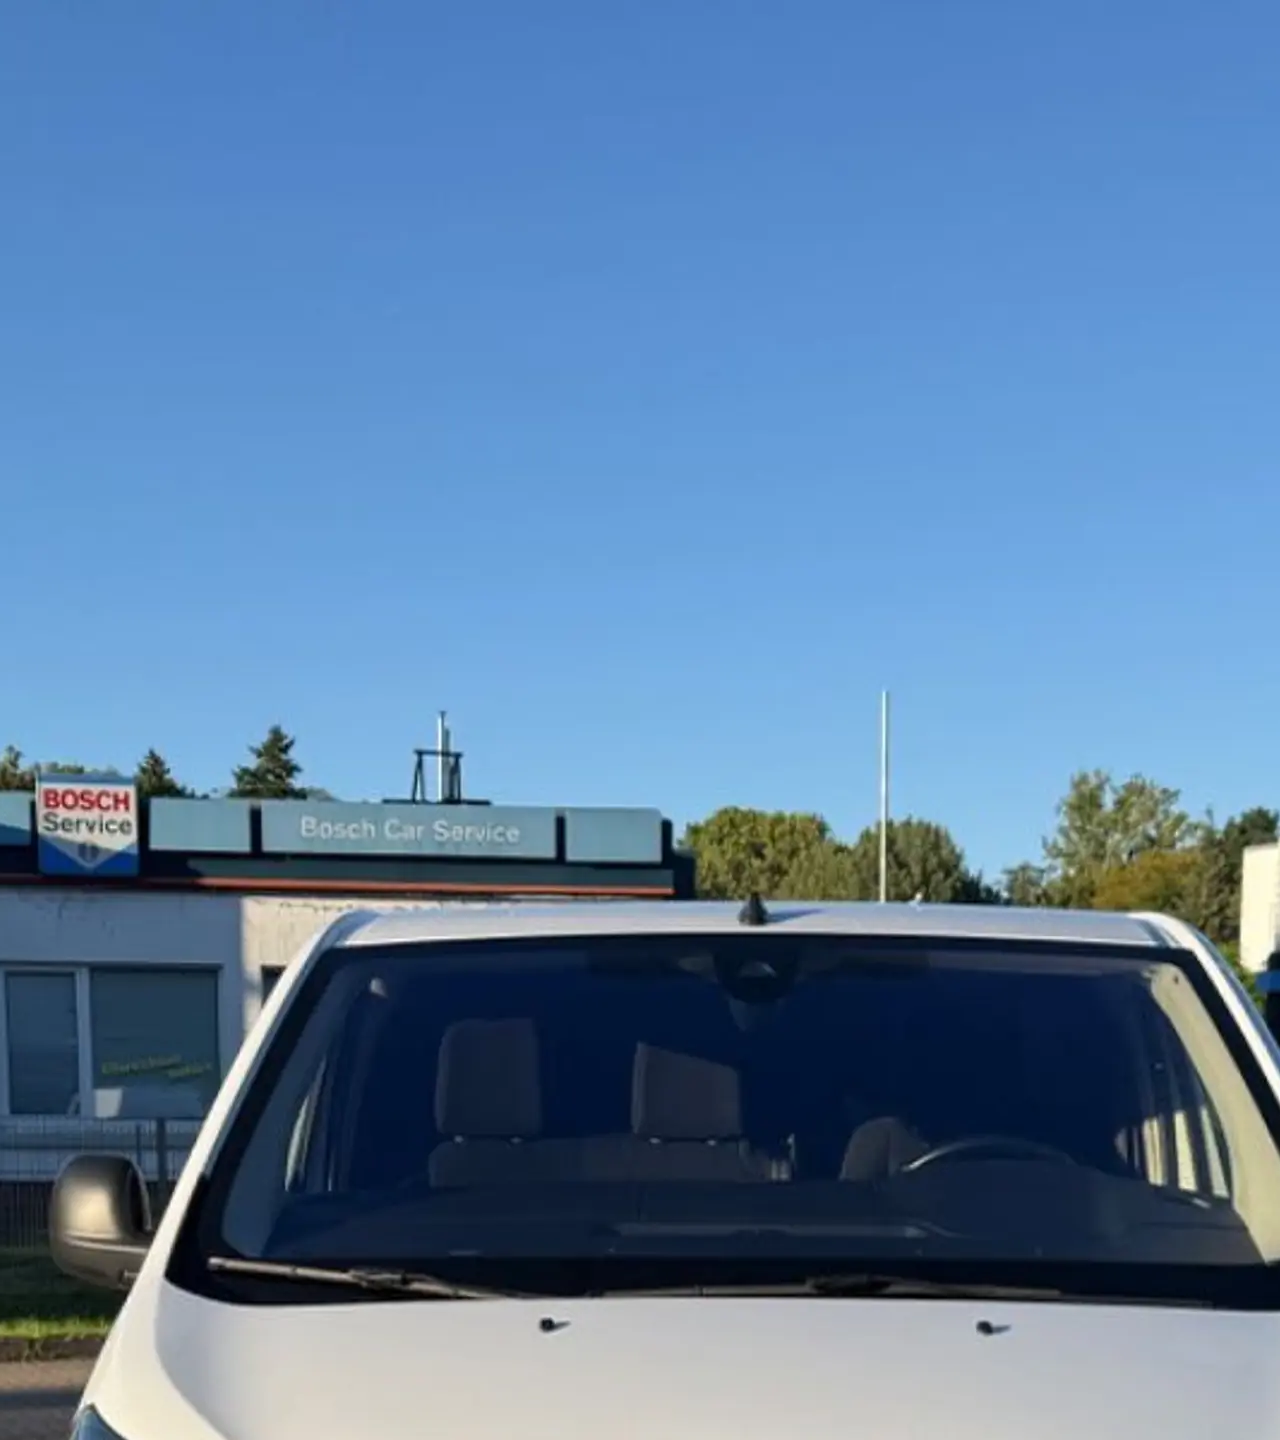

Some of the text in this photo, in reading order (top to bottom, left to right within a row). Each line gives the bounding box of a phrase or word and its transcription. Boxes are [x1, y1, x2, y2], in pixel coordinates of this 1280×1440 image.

[43, 788, 130, 811] BOSCH
[43, 812, 133, 835] Service
[300, 815, 520, 844] Bosch Car Service
